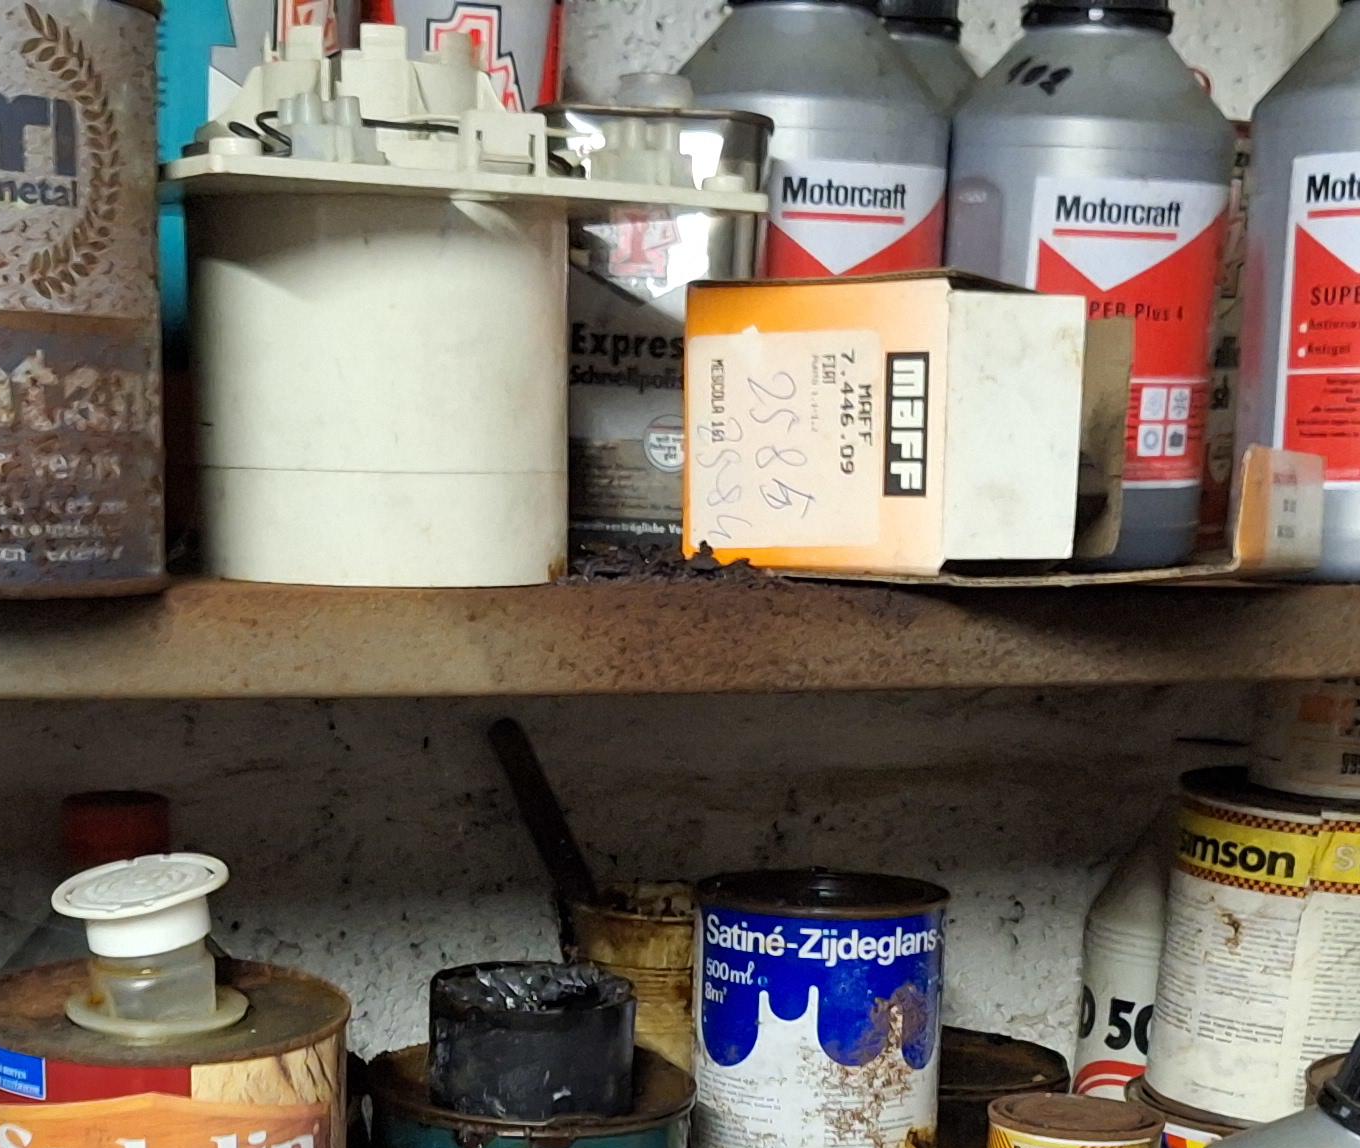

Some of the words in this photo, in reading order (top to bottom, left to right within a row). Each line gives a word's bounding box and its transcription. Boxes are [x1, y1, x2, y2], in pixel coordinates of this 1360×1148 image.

[782, 175, 906, 210] Motorcraft
[1055, 194, 1182, 229] Motorcraft
[1089, 302, 1127, 321] PER
[1135, 303, 1172, 322] Plus
[710, 359, 725, 415] MESCOLA
[822, 354, 836, 385] FIAT
[840, 348, 855, 475] 7.446.09
[857, 383, 874, 447] MAFF
